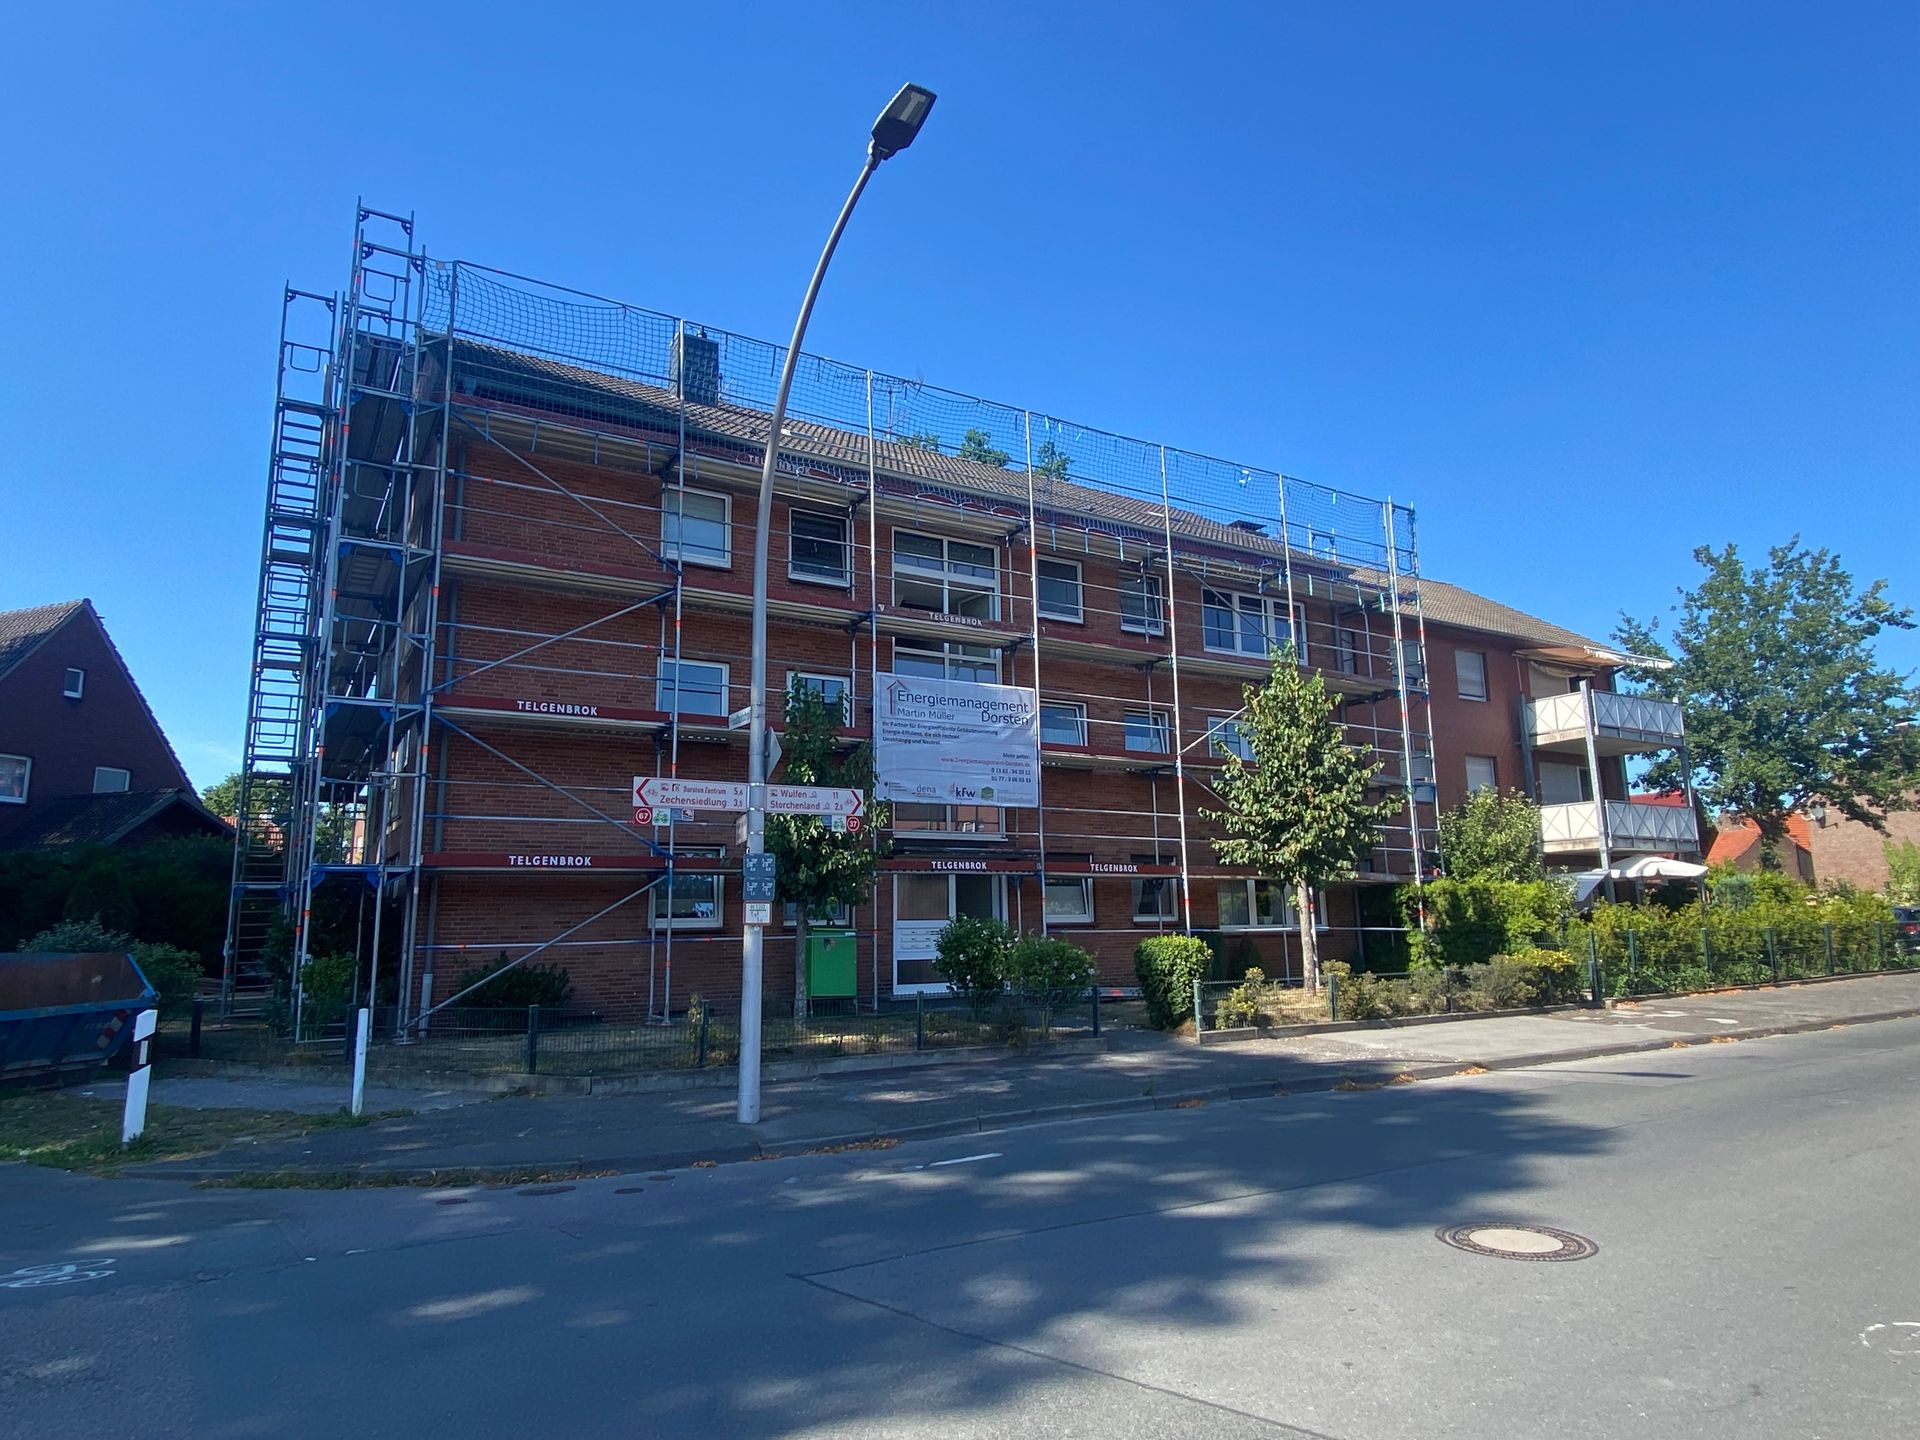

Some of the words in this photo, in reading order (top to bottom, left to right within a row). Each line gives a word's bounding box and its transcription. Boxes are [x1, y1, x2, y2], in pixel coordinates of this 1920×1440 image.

[928, 612, 983, 627] TELGENBROK
[897, 689, 1029, 713] Energiemanagement
[517, 700, 598, 716] TELGENBROK
[897, 707, 926, 718] Martin
[928, 710, 955, 721] Müller
[981, 710, 1029, 726] Dorsten
[683, 785, 704, 794] Dorsten
[704, 786, 727, 796] Zentrum
[780, 789, 807, 799] Wulfen
[832, 791, 839, 799] 11
[916, 783, 937, 794] dena
[660, 795, 727, 808] Zechensiedlung
[770, 800, 820, 810] Storchenland
[638, 812, 649, 820] 67
[508, 855, 592, 866] TELGENBROK
[931, 861, 987, 870] TELGENBROK
[1089, 863, 1138, 872] TELGENBROK
